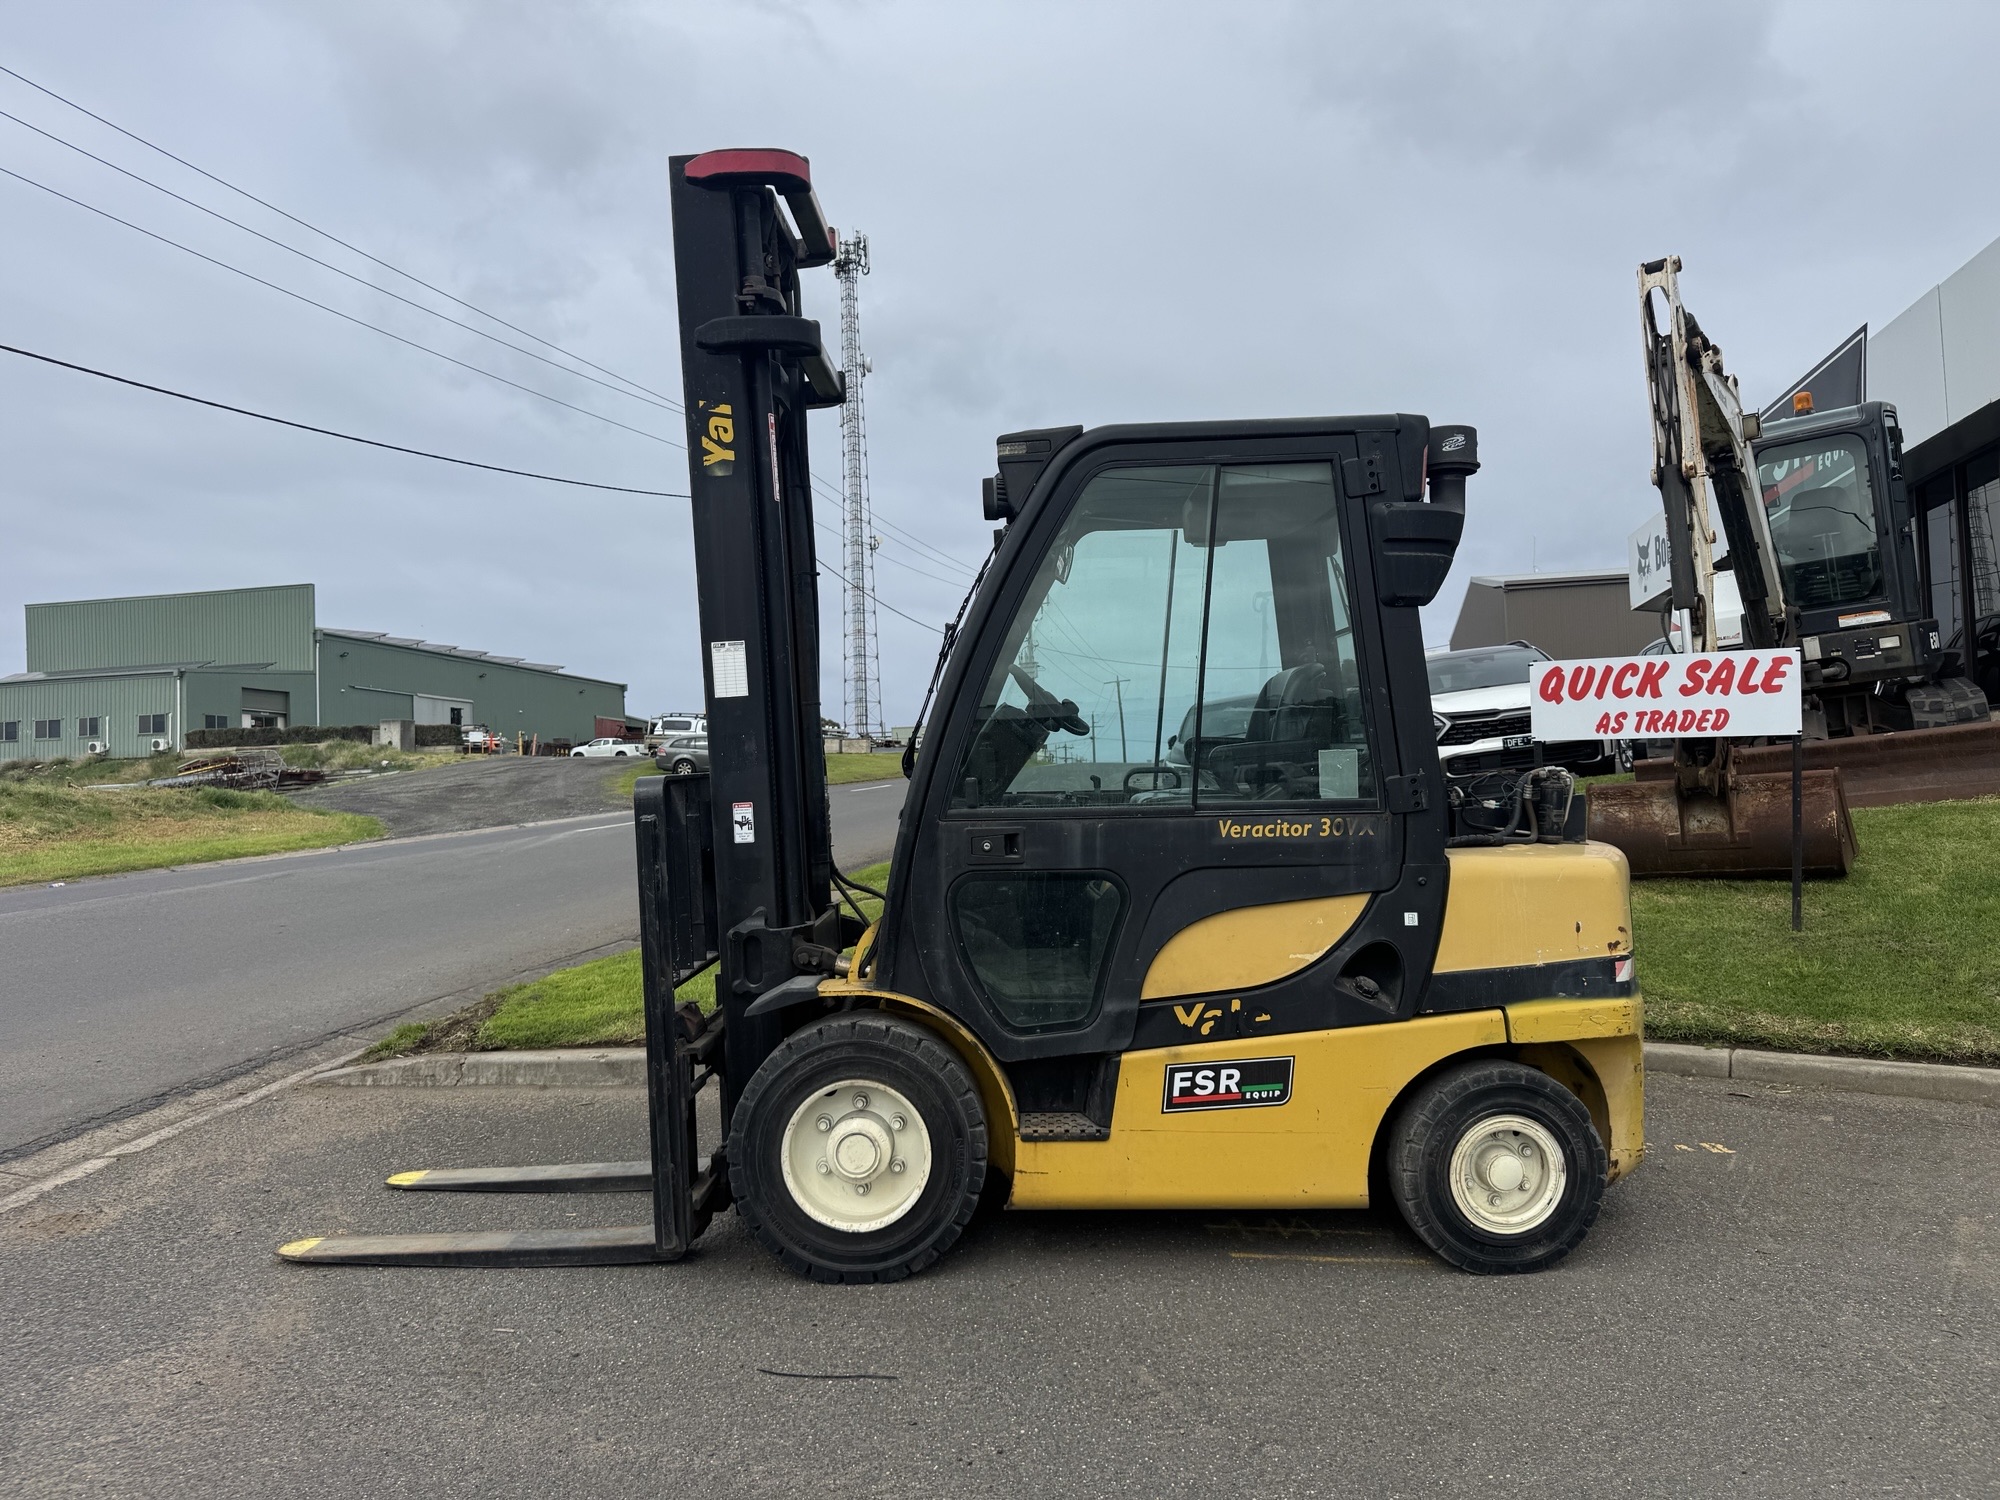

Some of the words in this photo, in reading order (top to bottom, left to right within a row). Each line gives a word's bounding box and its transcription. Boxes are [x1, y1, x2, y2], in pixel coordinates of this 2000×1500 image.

[1539, 660, 1670, 705] QUICK
[1678, 656, 1793, 697] SALE
[1595, 712, 1628, 734] AS
[1635, 708, 1730, 733] TRADED
[1219, 818, 1312, 838] Veracitor
[1319, 817, 1376, 837] 30VX
[1173, 1069, 1240, 1097] FSR
[1246, 1090, 1281, 1099] EQUIP
